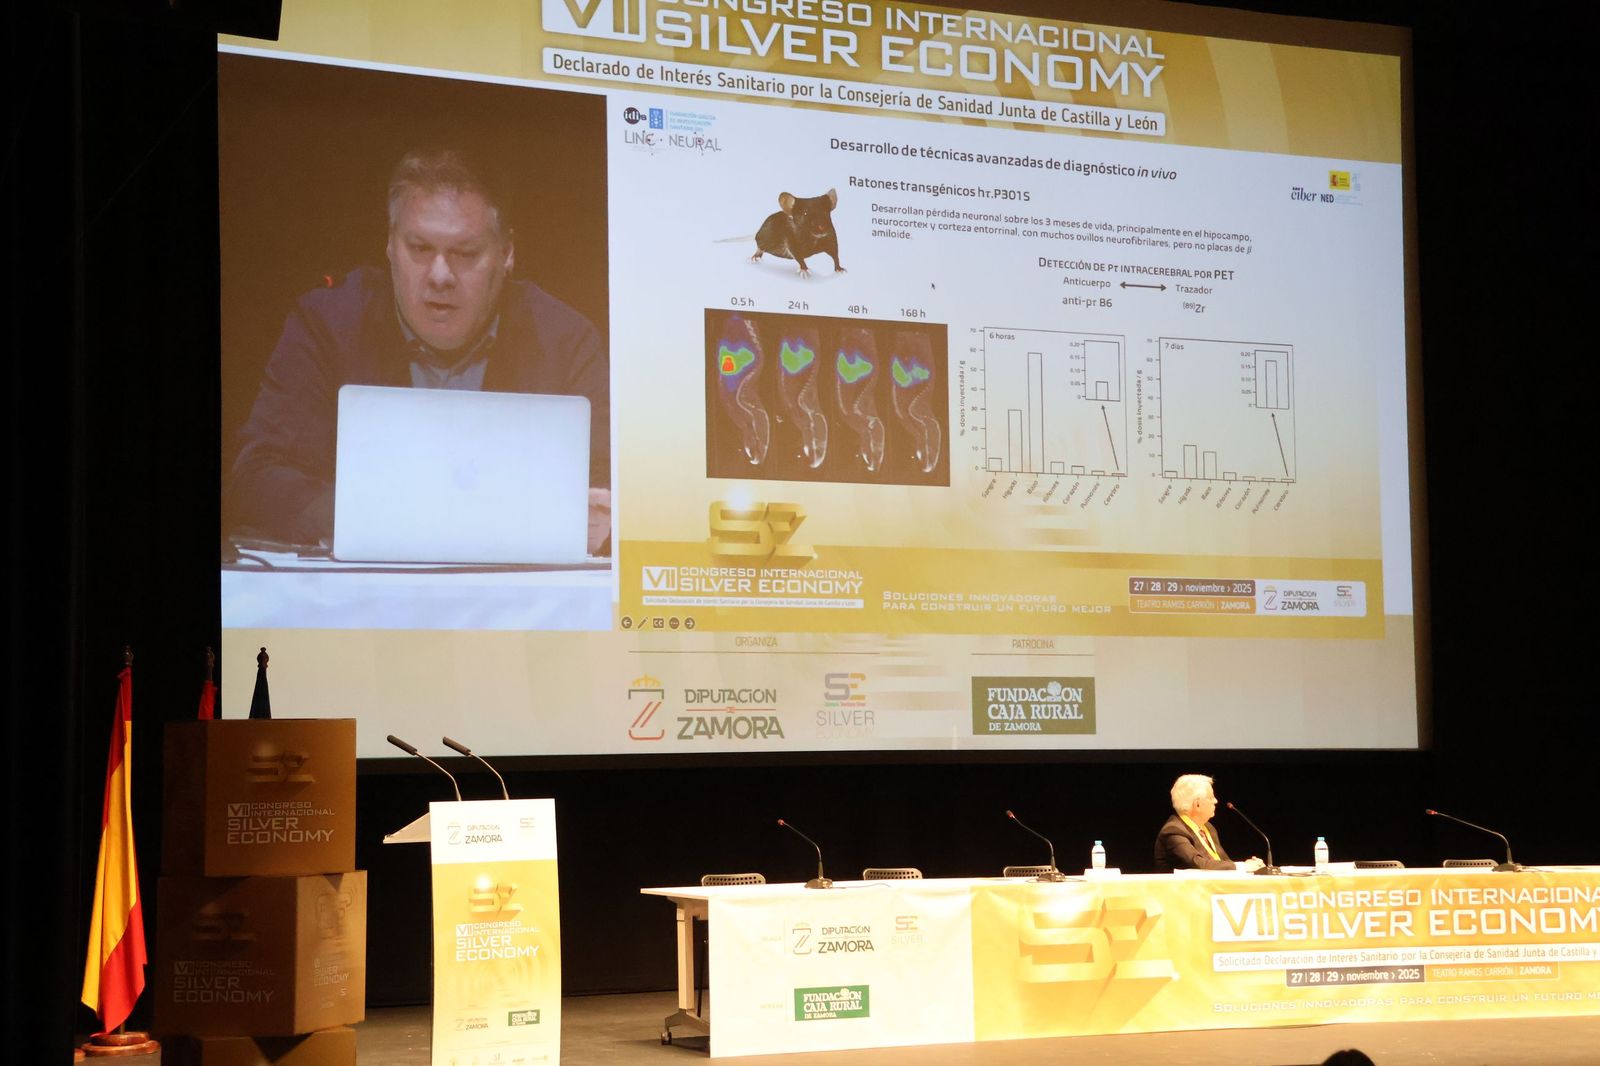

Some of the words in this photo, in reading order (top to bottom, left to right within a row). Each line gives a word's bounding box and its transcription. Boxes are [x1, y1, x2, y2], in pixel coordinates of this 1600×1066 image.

[657, 0, 872, 26] GRESO
[886, 7, 1165, 59] INTERNACIONAL
[655, 9, 860, 67] SILVER
[881, 35, 1165, 97] ECONOMY
[553, 54, 630, 78] Declarado
[637, 63, 654, 80] de
[660, 65, 712, 87] Interés
[717, 72, 786, 94] Sanitario
[791, 82, 816, 99] por
[820, 83, 833, 99] la
[838, 85, 911, 108] Consejería
[916, 93, 932, 109] de
[938, 95, 993, 116] Sanidad
[998, 101, 1036, 120] Junta
[1041, 105, 1056, 122] de
[1062, 108, 1110, 127] Castilla
[1114, 116, 1122, 131] y
[1127, 115, 1158, 131] León
[830, 138, 899, 155] Desarrollo
[901, 145, 917, 157] de
[920, 147, 974, 162] técnicas
[976, 154, 1043, 169] avanzadas
[1046, 158, 1061, 170] de
[1063, 160, 1135, 177] diagnóstico
[1137, 166, 1148, 178] in
[1151, 168, 1177, 180] vivo
[849, 176, 898, 190] Ratones
[900, 181, 975, 197] transgénicos
[1320, 194, 1334, 203] NED
[872, 203, 924, 216] Desarrollan
[926, 208, 960, 219] pérdida
[962, 213, 1002, 222] neuronal
[1004, 215, 1029, 224] sobre
[1031, 216, 1043, 226] los
[1045, 218, 1051, 226] 3
[1053, 219, 1080, 228] meses
[1082, 221, 1093, 229] de
[1094, 222, 1115, 232] vida,
[1117, 224, 1181, 237] principalmente
[1194, 230, 1202, 238] el
[1203, 230, 1252, 243] hipocampo,
[871, 228, 912, 240] amiloide.
[871, 217, 928, 229] neurocortex
[930, 223, 935, 231] y
[938, 223, 972, 232] corteza
[974, 226, 1020, 237] entorrinal,
[1022, 229, 1038, 237] con
[1041, 230, 1075, 241] muchos
[1076, 233, 1104, 243] ovillos
[1106, 235, 1171, 249] neurofibrilares,
[1173, 241, 1192, 250] pero
[1194, 242, 1205, 250] no
[1207, 242, 1232, 252] placas
[1235, 245, 1245, 253] de
[1093, 262, 1106, 272] DE
[1120, 265, 1192, 278] INTRACEREBRAL
[1194, 270, 1212, 279] POR
[1214, 269, 1235, 281] PET
[1063, 276, 1111, 289] Anticuerpo
[1176, 284, 1213, 295] Trazador
[731, 297, 747, 306] 0.5
[748, 298, 755, 307] h
[788, 300, 800, 310] 24
[802, 301, 809, 310] h
[1099, 298, 1113, 308] B6
[848, 305, 860, 314] 48
[861, 305, 868, 314] h
[901, 308, 918, 318] 168
[920, 309, 926, 318] h
[995, 333, 1015, 341] horas
[643, 568, 676, 590] VII
[680, 567, 756, 577] CONGRESO
[760, 569, 863, 580] INTERNACIONAL
[680, 578, 751, 592] SILVER
[758, 579, 863, 594] ECONOMY
[1133, 581, 1144, 591] 27
[1150, 582, 1162, 592] 28
[1167, 582, 1178, 592] 29
[1185, 583, 1226, 593] noviembre
[1232, 583, 1252, 593] 2025
[969, 593, 1057, 603] INNOVADORAS
[883, 602, 915, 610] PARA
[921, 602, 993, 612] CONSTRUIR
[997, 603, 1014, 612] UN
[1019, 604, 1067, 613] FUTURO
[1072, 605, 1112, 614] MEJOR
[1221, 601, 1250, 609] ZAMORA
[1281, 601, 1319, 610] ZAMORA
[735, 636, 778, 647] ORGANIZA
[1012, 639, 1054, 649] PATROCINA
[816, 710, 875, 726] SILVER
[988, 704, 1026, 720] CAJA
[1031, 704, 1083, 719] RURAL
[676, 716, 785, 740] ZAMORA
[989, 722, 1001, 731] DE
[1004, 722, 1041, 731] ZAMORA
[251, 801, 312, 809] CONGRESO
[228, 817, 299, 831] SILVER
[227, 829, 334, 844] ECONOMY
[465, 834, 503, 845] ZAMORA
[1214, 896, 1276, 938] VII
[1281, 889, 1421, 909] CONGRESO
[1284, 911, 1415, 940] SILVER
[456, 936, 511, 949] SILVER
[818, 940, 874, 954] ZAMORA
[456, 946, 539, 962] ECONOMY
[1219, 953, 1261, 967] Solicitado
[1316, 954, 1326, 964] de
[1360, 951, 1398, 962] Sanitario
[1402, 952, 1415, 962] por
[1420, 951, 1427, 960] la
[1474, 949, 1484, 958] de
[1487, 948, 1519, 958] Sanidad
[1522, 947, 1546, 958] Junta
[1549, 948, 1559, 957] de
[1561, 946, 1589, 957] Castilla
[1291, 973, 1302, 983] 27
[1309, 972, 1321, 983] 28
[1326, 971, 1338, 982] 29
[1346, 969, 1389, 982] noviembre
[1398, 968, 1420, 980] 2025
[1519, 966, 1552, 975] ZAMORA
[174, 977, 240, 989] SILVER
[173, 990, 274, 1002] ECONOMY
[1438, 994, 1506, 1004] CONSTRUIR
[1512, 993, 1529, 1002] UN
[1534, 992, 1582, 1001] FUTURO
[803, 1002, 828, 1012] CAJA
[830, 1000, 862, 1011] RURAL
